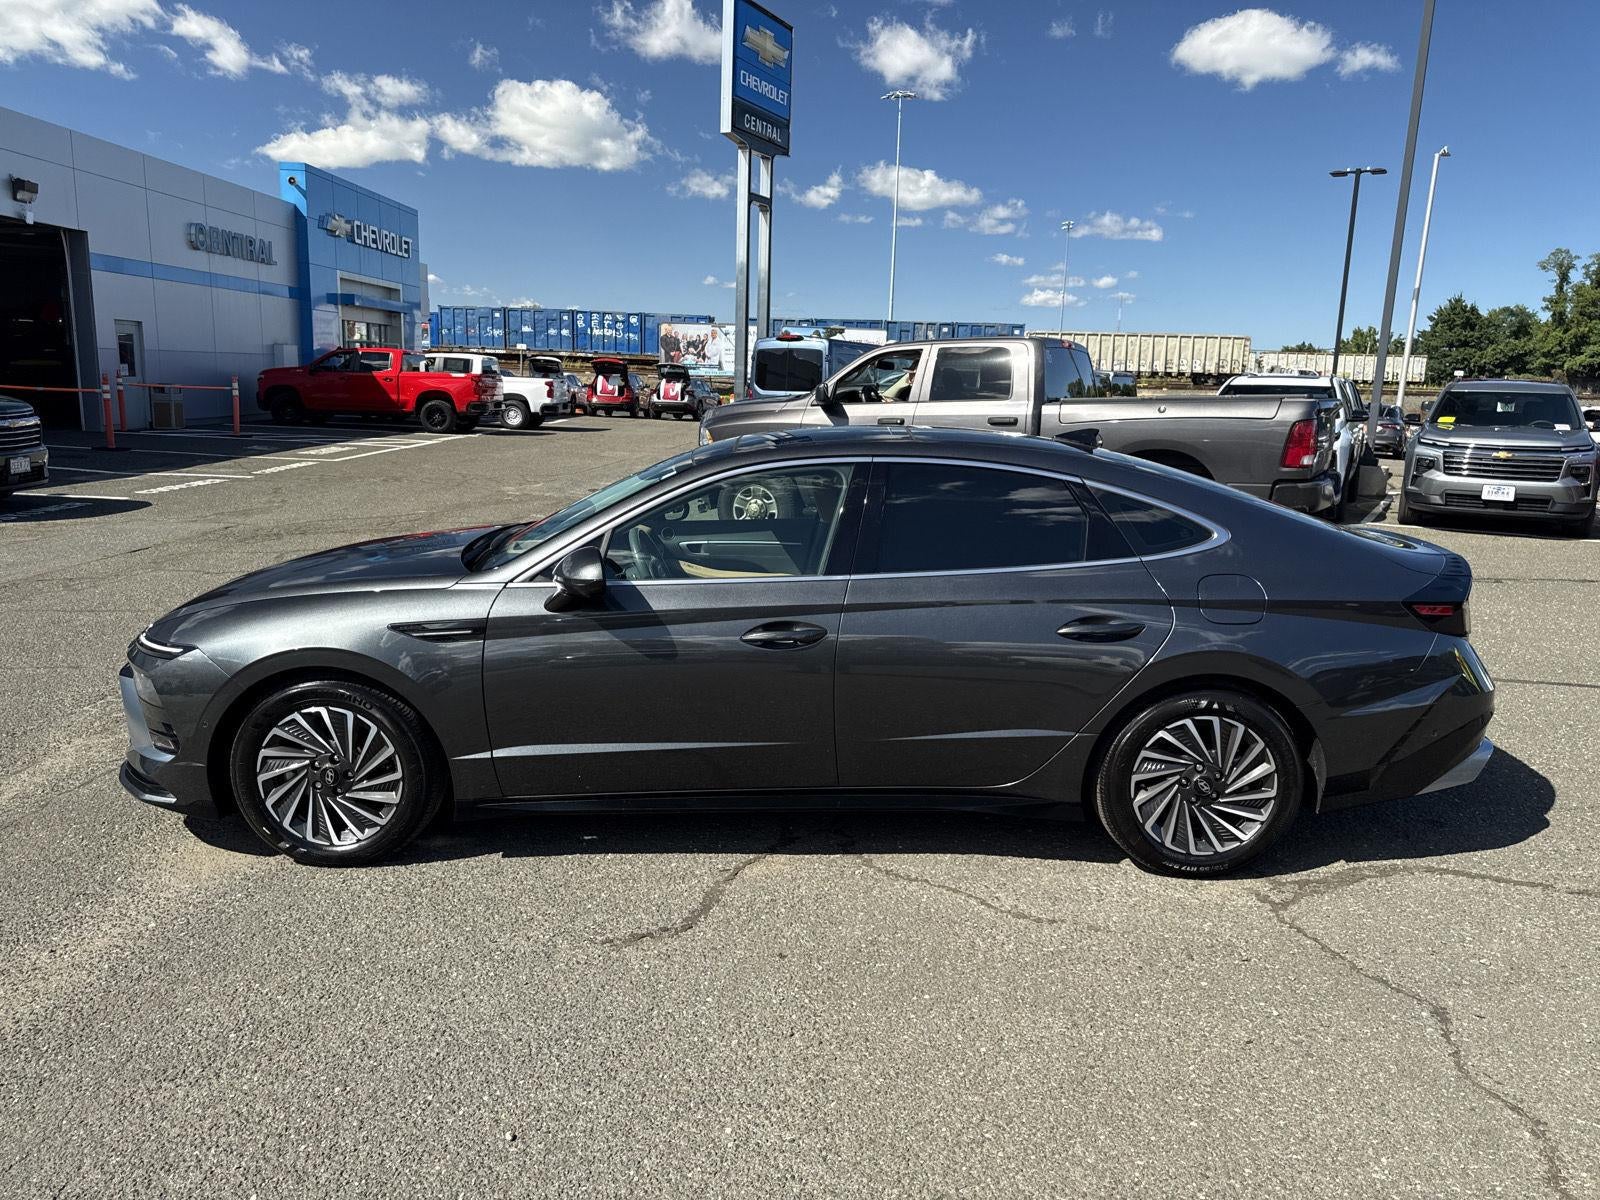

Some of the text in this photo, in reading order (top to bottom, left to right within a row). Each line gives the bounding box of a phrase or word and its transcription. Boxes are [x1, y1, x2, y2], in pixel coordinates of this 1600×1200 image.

[740, 70, 789, 106] CHEVROLET
[744, 113, 782, 142] CENTRAL
[188, 222, 278, 265] CENTRAL
[353, 220, 413, 258] CHEVROLET
